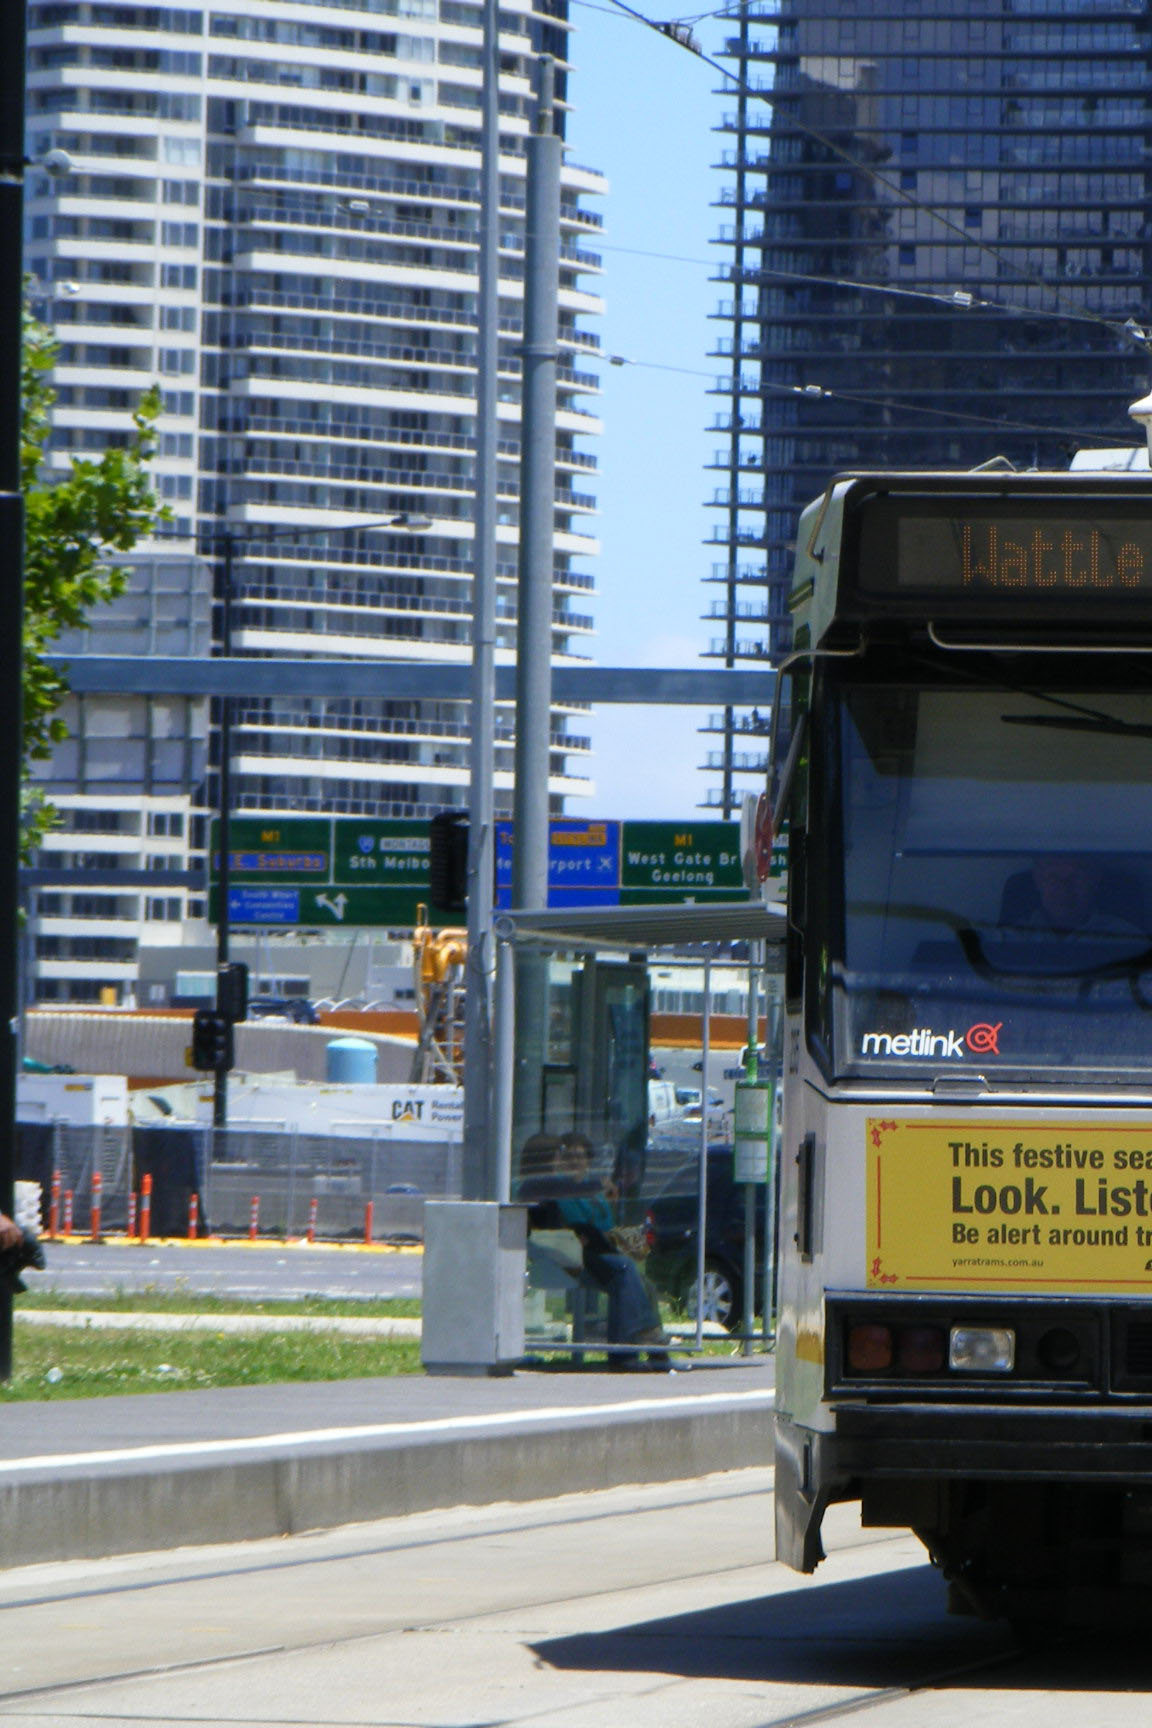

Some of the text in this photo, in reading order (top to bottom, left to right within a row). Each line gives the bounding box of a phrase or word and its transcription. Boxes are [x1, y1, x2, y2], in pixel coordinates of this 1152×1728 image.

[961, 526, 1144, 589] Wattle
[674, 834, 693, 847] M1
[350, 855, 430, 870] Sth Melbo
[550, 858, 592, 873] rport
[628, 852, 737, 866] West Gate Br
[651, 869, 715, 886] Geelong
[862, 1028, 965, 1057] metlink
[392, 1100, 424, 1121] CAT
[948, 1142, 1004, 1168] This
[1012, 1142, 1104, 1169] festive
[952, 1176, 1061, 1215] Look.
[952, 1222, 979, 1244] Be
[987, 1223, 1041, 1245] alert
[1049, 1225, 1129, 1247] around
[952, 1257, 1044, 1268] yarratrams.com.au
